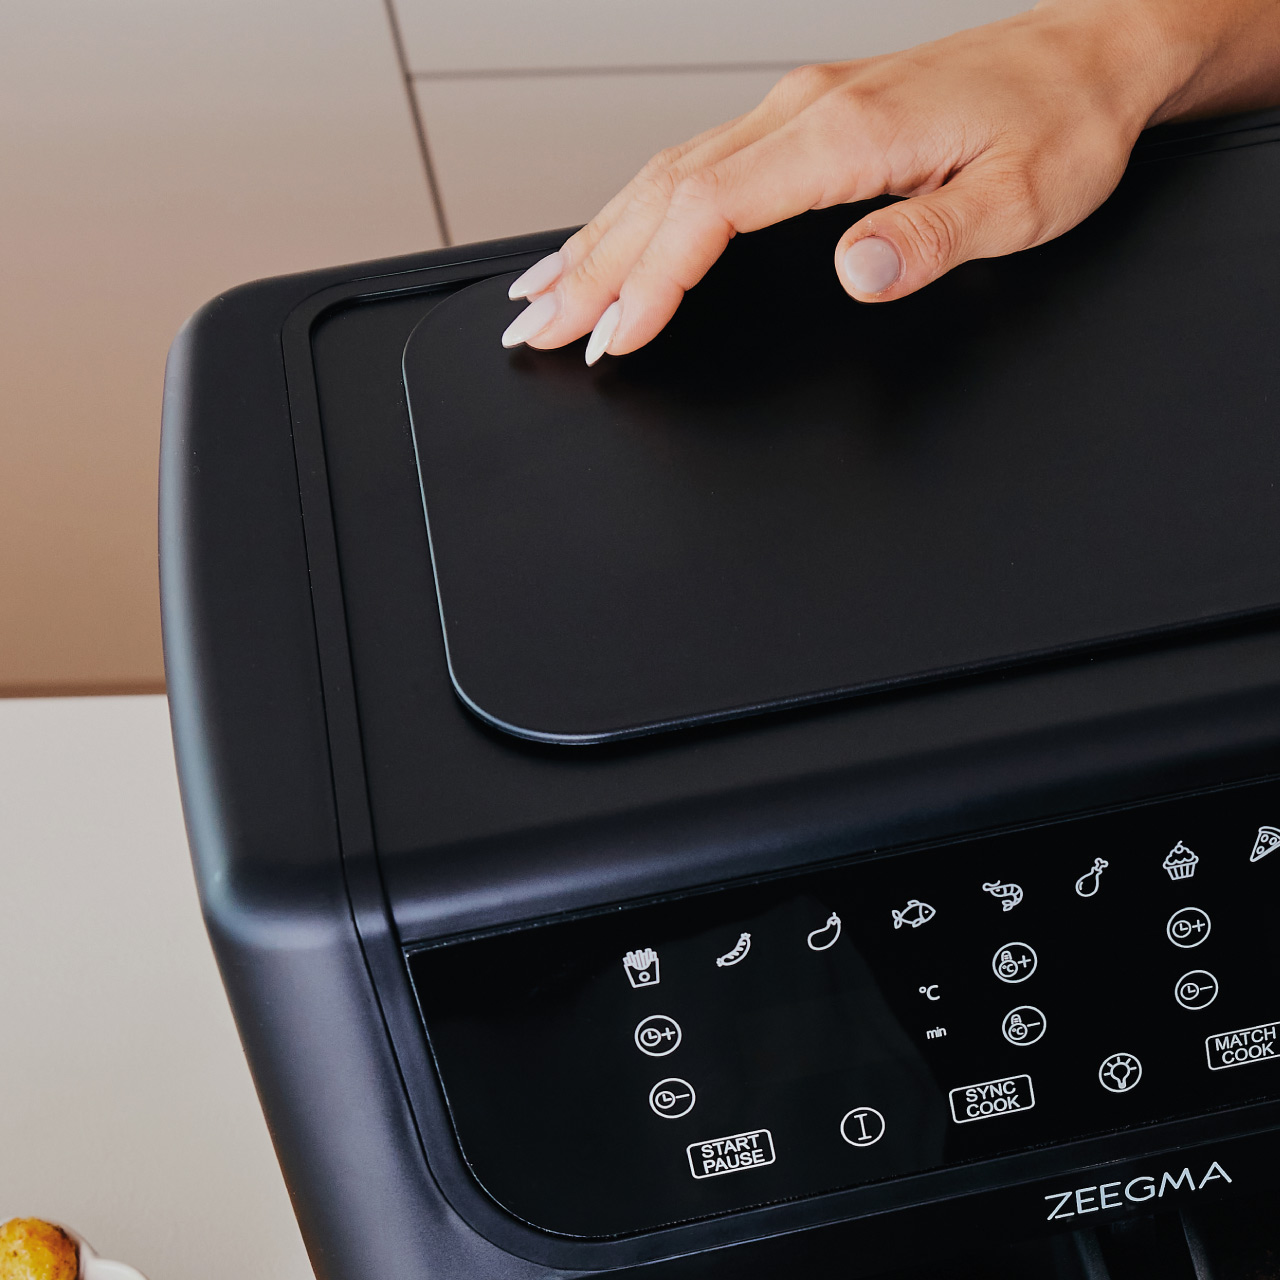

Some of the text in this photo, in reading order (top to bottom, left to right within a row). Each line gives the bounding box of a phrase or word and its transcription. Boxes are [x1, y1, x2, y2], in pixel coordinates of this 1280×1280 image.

[918, 984, 941, 1001] °C
[926, 1025, 947, 1040] min
[1214, 1026, 1277, 1052] MATCH
[1221, 1041, 1275, 1066] COOK
[965, 1080, 1017, 1103] SYNC
[966, 1094, 1021, 1118] COOK
[701, 1133, 760, 1159] START
[702, 1148, 766, 1174] PAUSE
[1044, 1161, 1233, 1221] ZEEGMA
